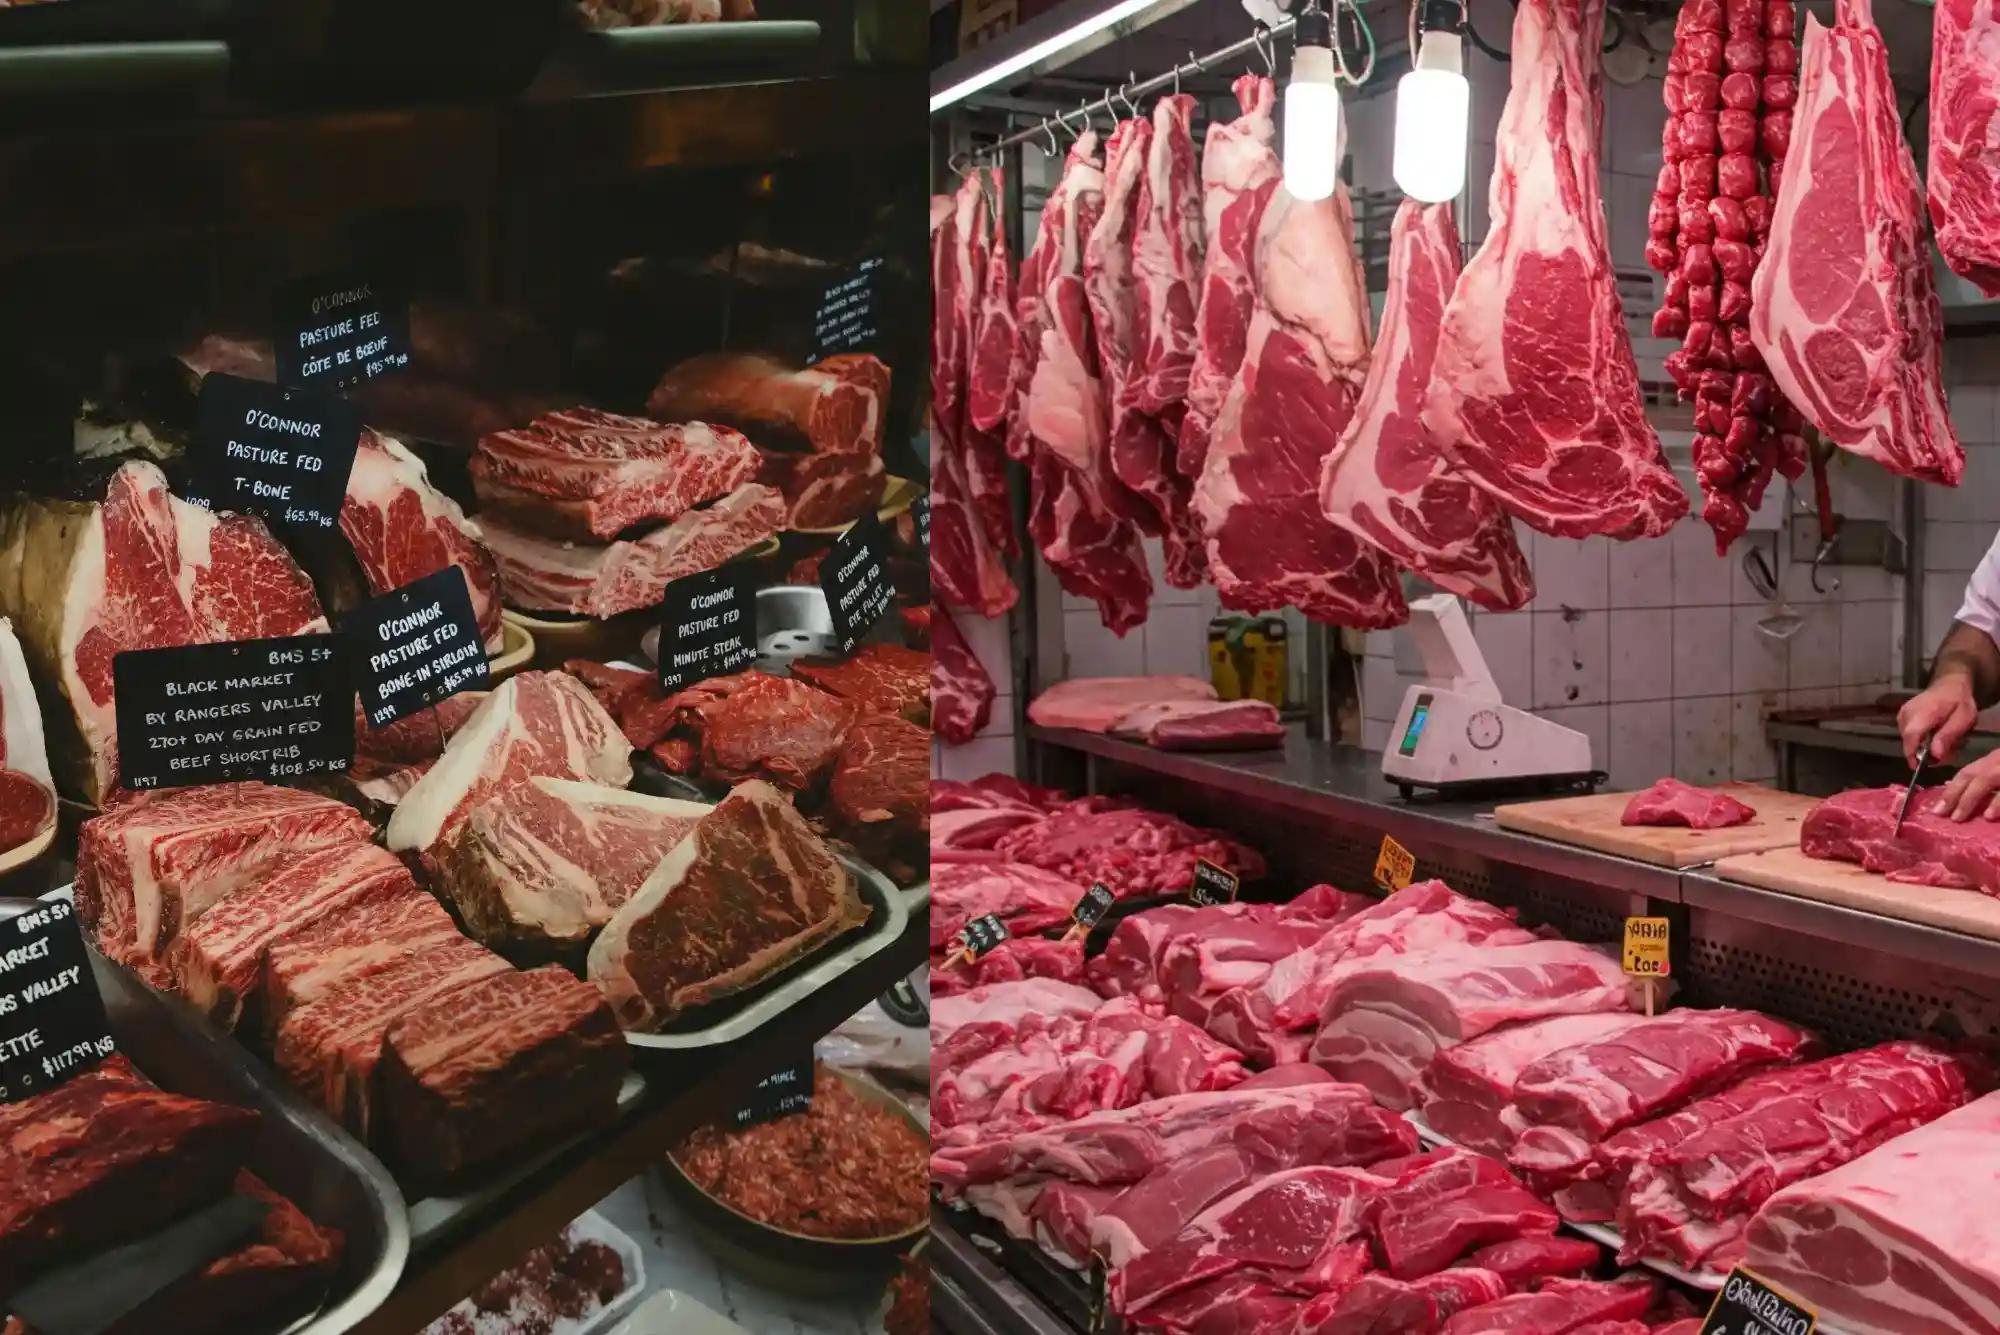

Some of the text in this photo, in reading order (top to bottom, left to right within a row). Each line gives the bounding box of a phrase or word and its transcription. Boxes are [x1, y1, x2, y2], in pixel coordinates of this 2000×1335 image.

[300, 319, 354, 348] PASTURE
[302, 356, 332, 377] CÔTE
[336, 349, 352, 365] DE
[246, 409, 321, 437] O'CONNOR
[227, 440, 322, 472] PASTURE FED
[284, 504, 332, 527] $65.99 KG
[837, 545, 870, 583] O'CONNOR
[690, 587, 734, 610] O'CONNOR
[839, 563, 880, 612] PASTURE FED
[848, 582, 884, 628] EYE FILLET
[379, 601, 443, 641] O'CONNOR
[678, 609, 739, 639] PASTURE FED
[269, 649, 333, 665] BMS 5+
[370, 623, 458, 673] PASTURE FED
[673, 636, 741, 668] MINUTE STEAK
[166, 672, 294, 697] BLACK MARKET
[378, 640, 479, 700] BONE-IN SIRLOIN
[444, 662, 487, 692] $65.99 KG
[664, 674, 681, 687] 1397
[145, 694, 322, 725] BY RANGERS VALLEY
[373, 704, 396, 724] 1299
[149, 735, 187, 749] 270+
[194, 731, 225, 744] DAY
[289, 721, 322, 735] FED
[170, 745, 301, 770] BEEF SHORT RIB
[270, 758, 346, 776] $108.50 KG
[134, 777, 158, 787] 1197
[16, 904, 70, 934] BMS 5+
[22, 965, 80, 1004] VALLEY
[41, 1035, 115, 1078] $117.99 KG
